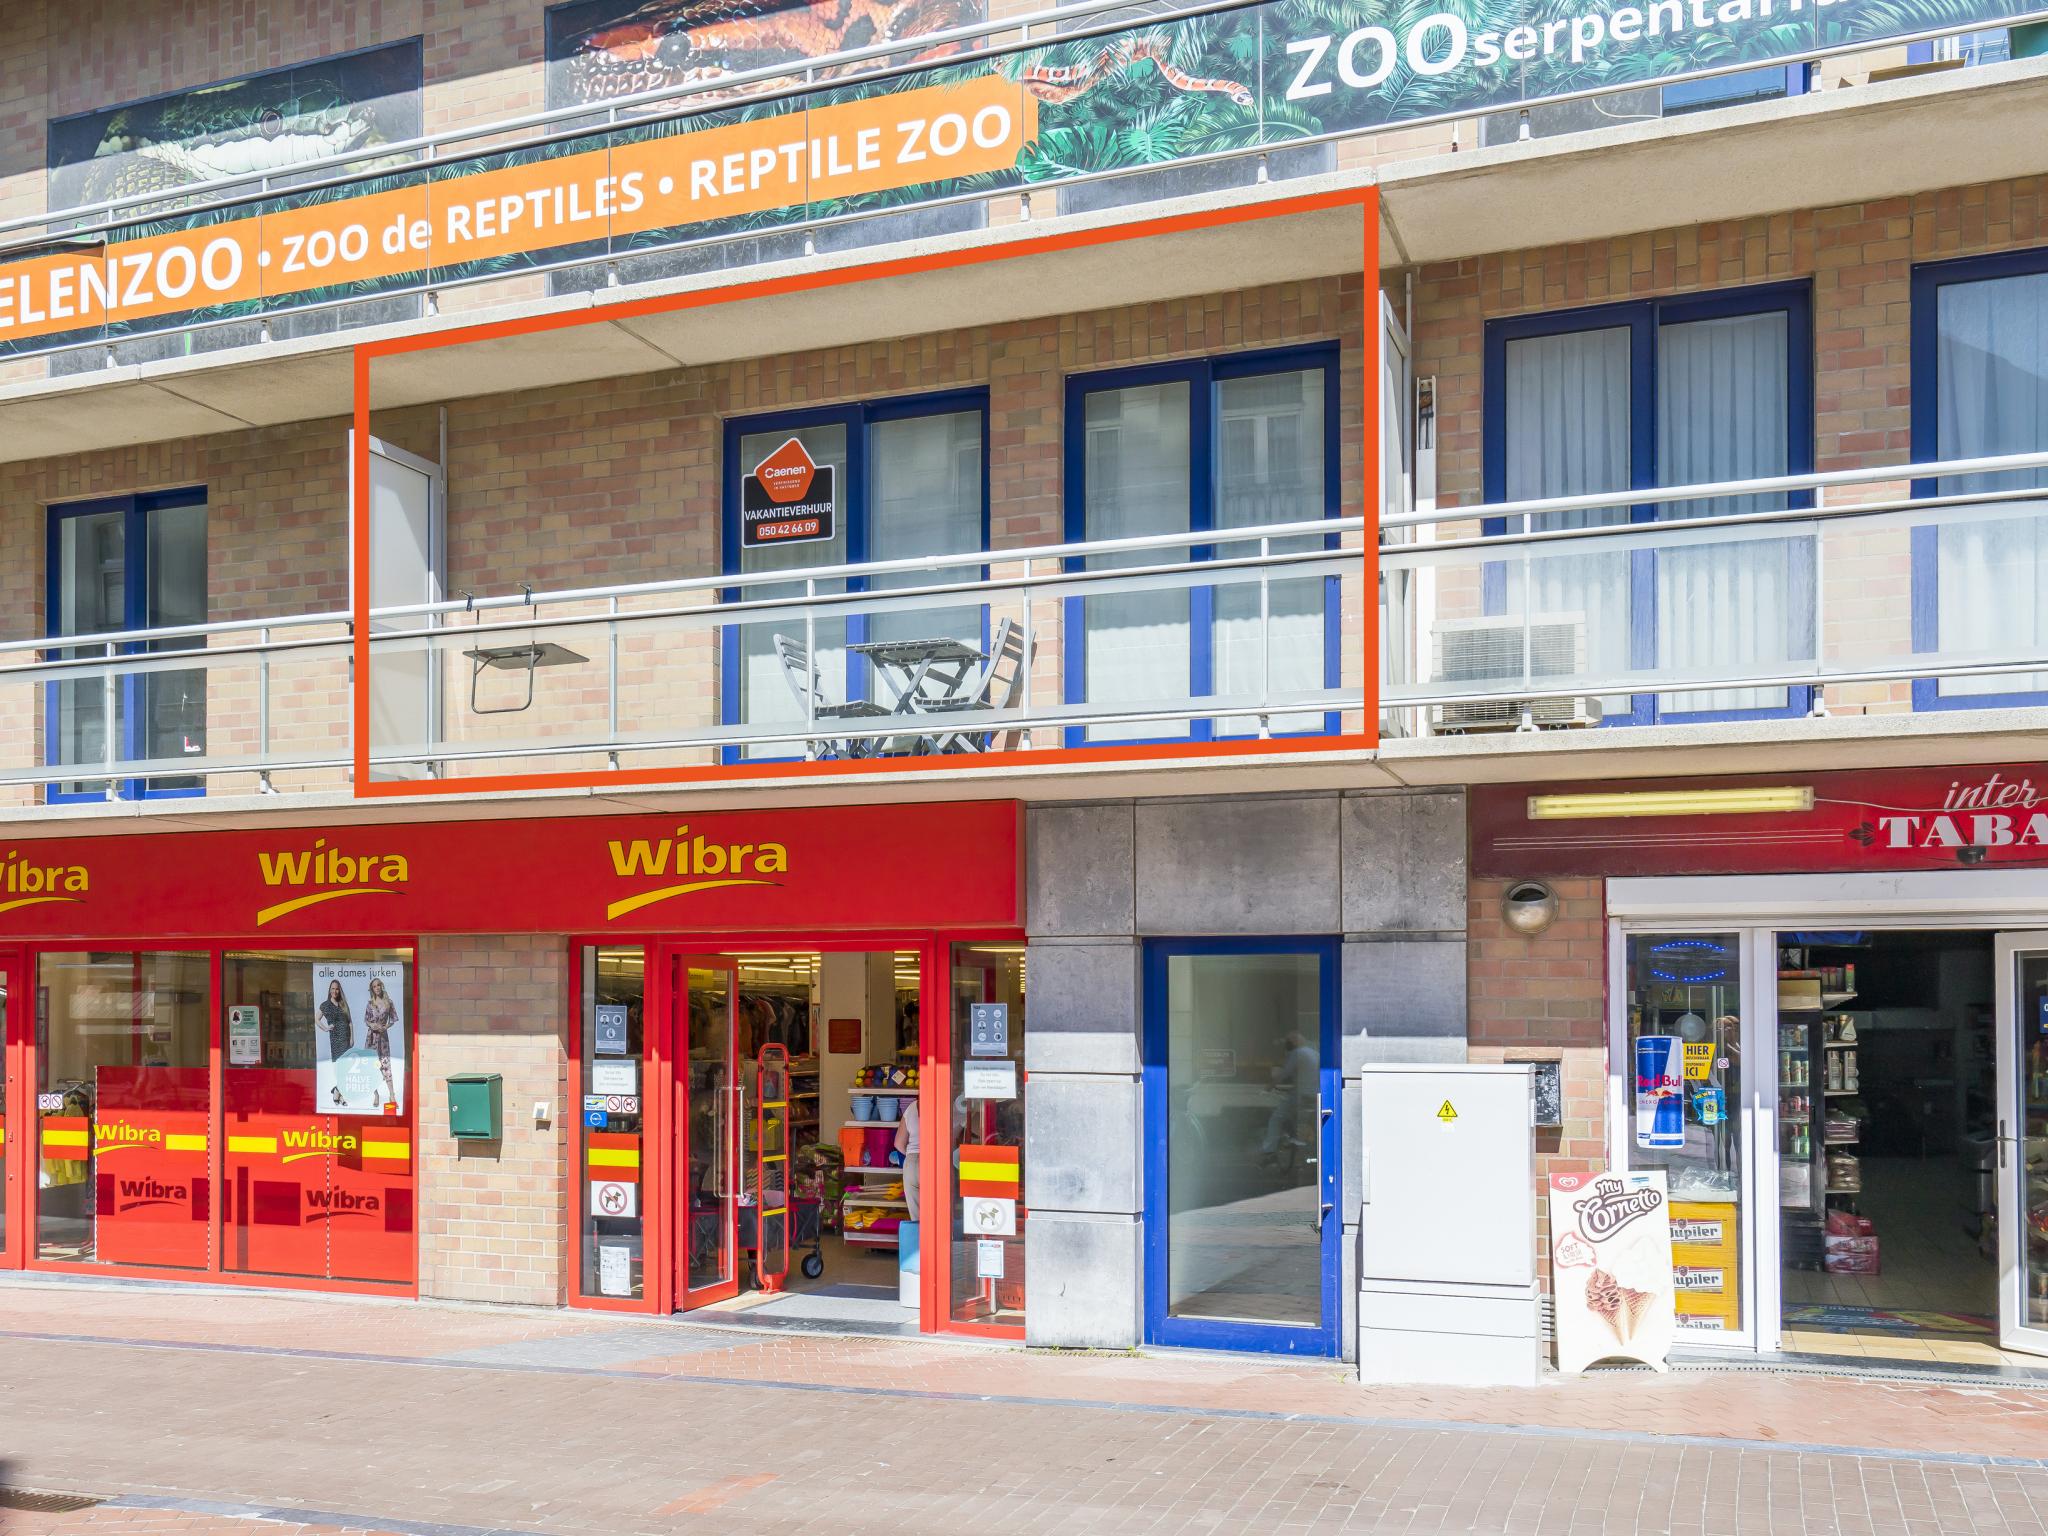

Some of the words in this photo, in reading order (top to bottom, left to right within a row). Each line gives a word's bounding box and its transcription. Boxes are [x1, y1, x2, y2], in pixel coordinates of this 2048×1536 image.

[282, 223, 369, 274] ZOO
[381, 214, 432, 254] de
[447, 171, 645, 245] REPTILES
[691, 127, 881, 201] REPTILE
[896, 104, 1012, 164] ZOO
[764, 465, 806, 479] Caenen
[744, 502, 832, 521] VAKANTIEVERHUUR
[759, 526, 776, 537] 050
[778, 525, 790, 535] 42
[791, 523, 803, 533] 66
[805, 521, 817, 532] 09
[1943, 773, 2040, 813] inter
[257, 837, 409, 886] Wibra
[607, 824, 788, 877] Wibra
[0, 849, 90, 893] ibra
[318, 967, 335, 978] alle
[337, 967, 367, 978] dames
[369, 967, 397, 980] jurken
[1686, 1045, 1709, 1055] HIER
[1686, 1066, 1698, 1077] ICI
[93, 1119, 161, 1142] Wibra
[283, 1125, 357, 1150] Wibra
[120, 1175, 187, 1200] Wibra
[306, 1184, 380, 1211] Wibra
[1595, 1179, 1624, 1197] My
[1573, 1188, 1662, 1243] Cornetto
[1673, 1273, 1719, 1288] upiler
